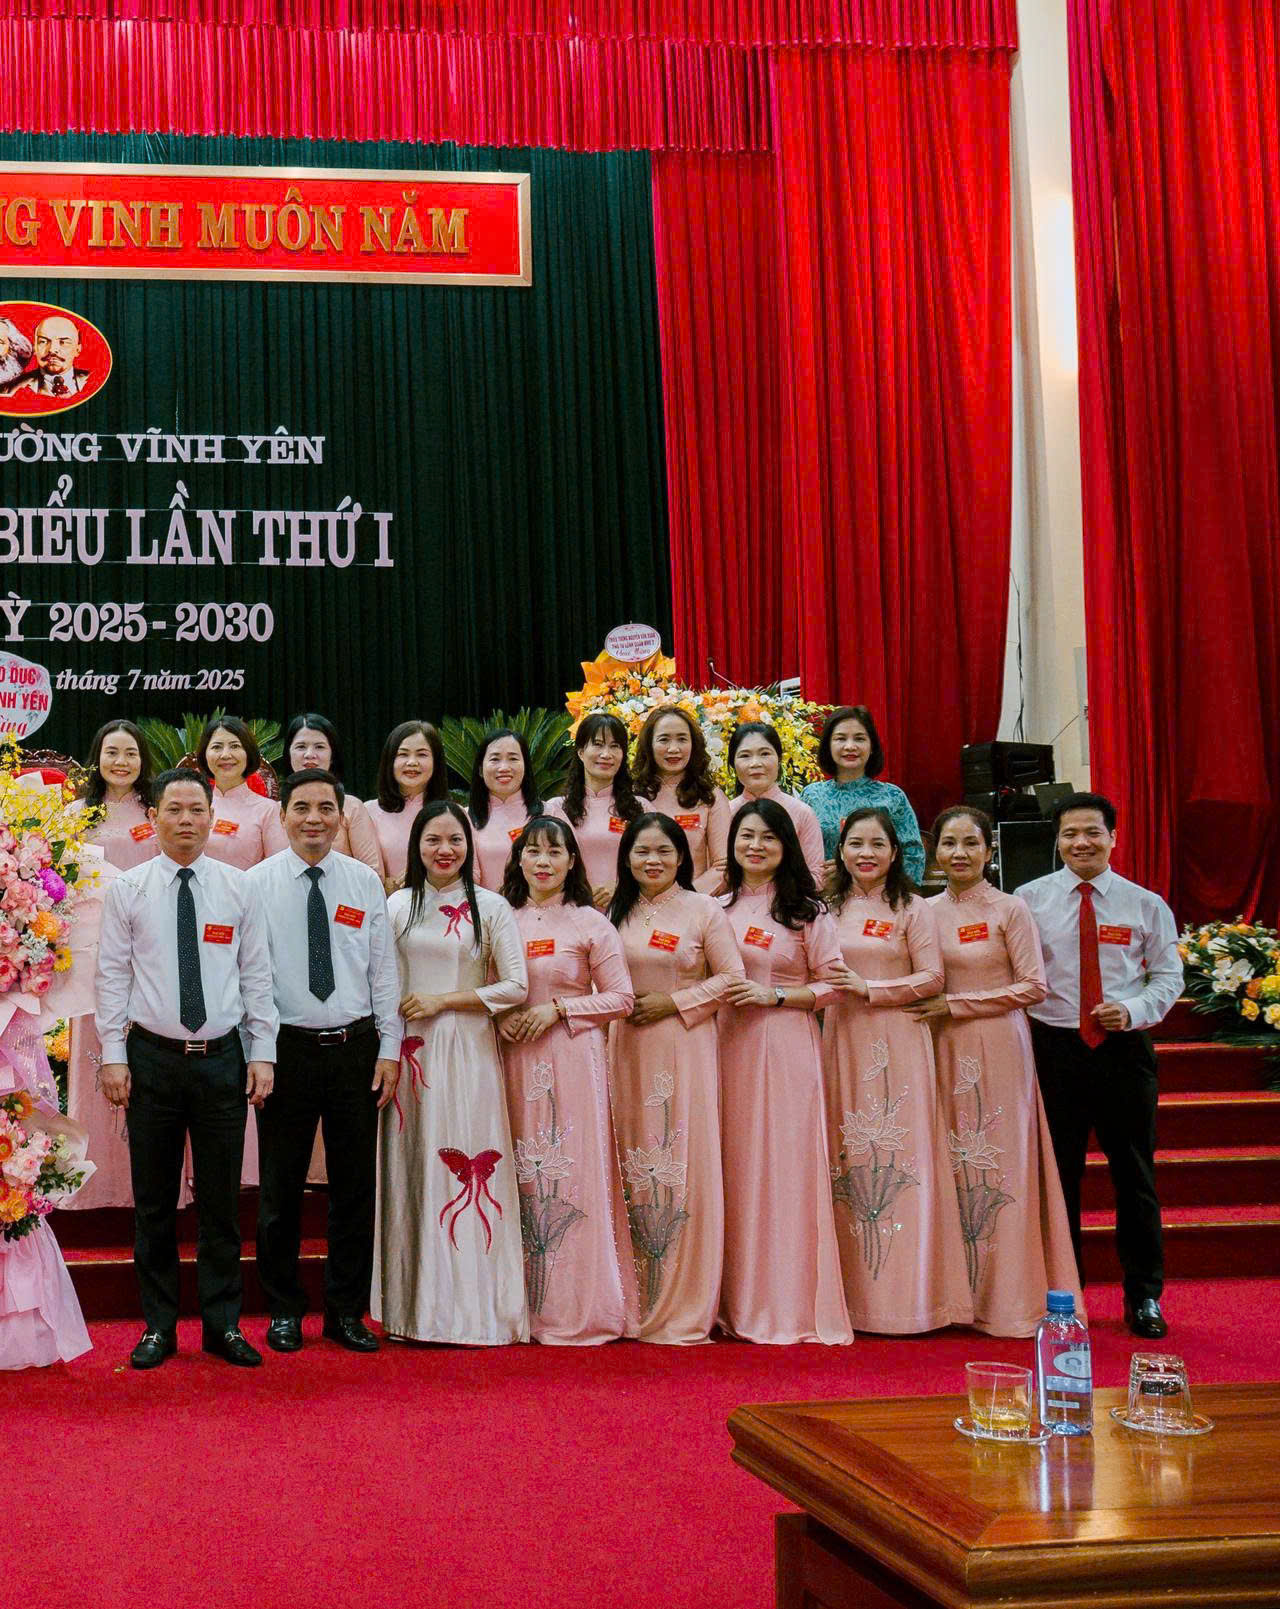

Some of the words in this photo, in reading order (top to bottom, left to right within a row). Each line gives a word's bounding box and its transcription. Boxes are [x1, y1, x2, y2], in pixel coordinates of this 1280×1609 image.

[53, 199, 183, 248] VINH
[196, 187, 346, 250] MUÔN
[360, 191, 470, 253] NĂM
[116, 428, 223, 463] VĨNH
[236, 426, 325, 464] YÊN
[125, 480, 236, 566] LẦN
[252, 496, 363, 568] THỨ
[374, 512, 394, 568] I
[56, 668, 120, 694] tháng
[128, 670, 141, 690] 7
[143, 670, 192, 690] năm
[195, 669, 245, 690] 2025
[21, 689, 50, 712] YÊN
